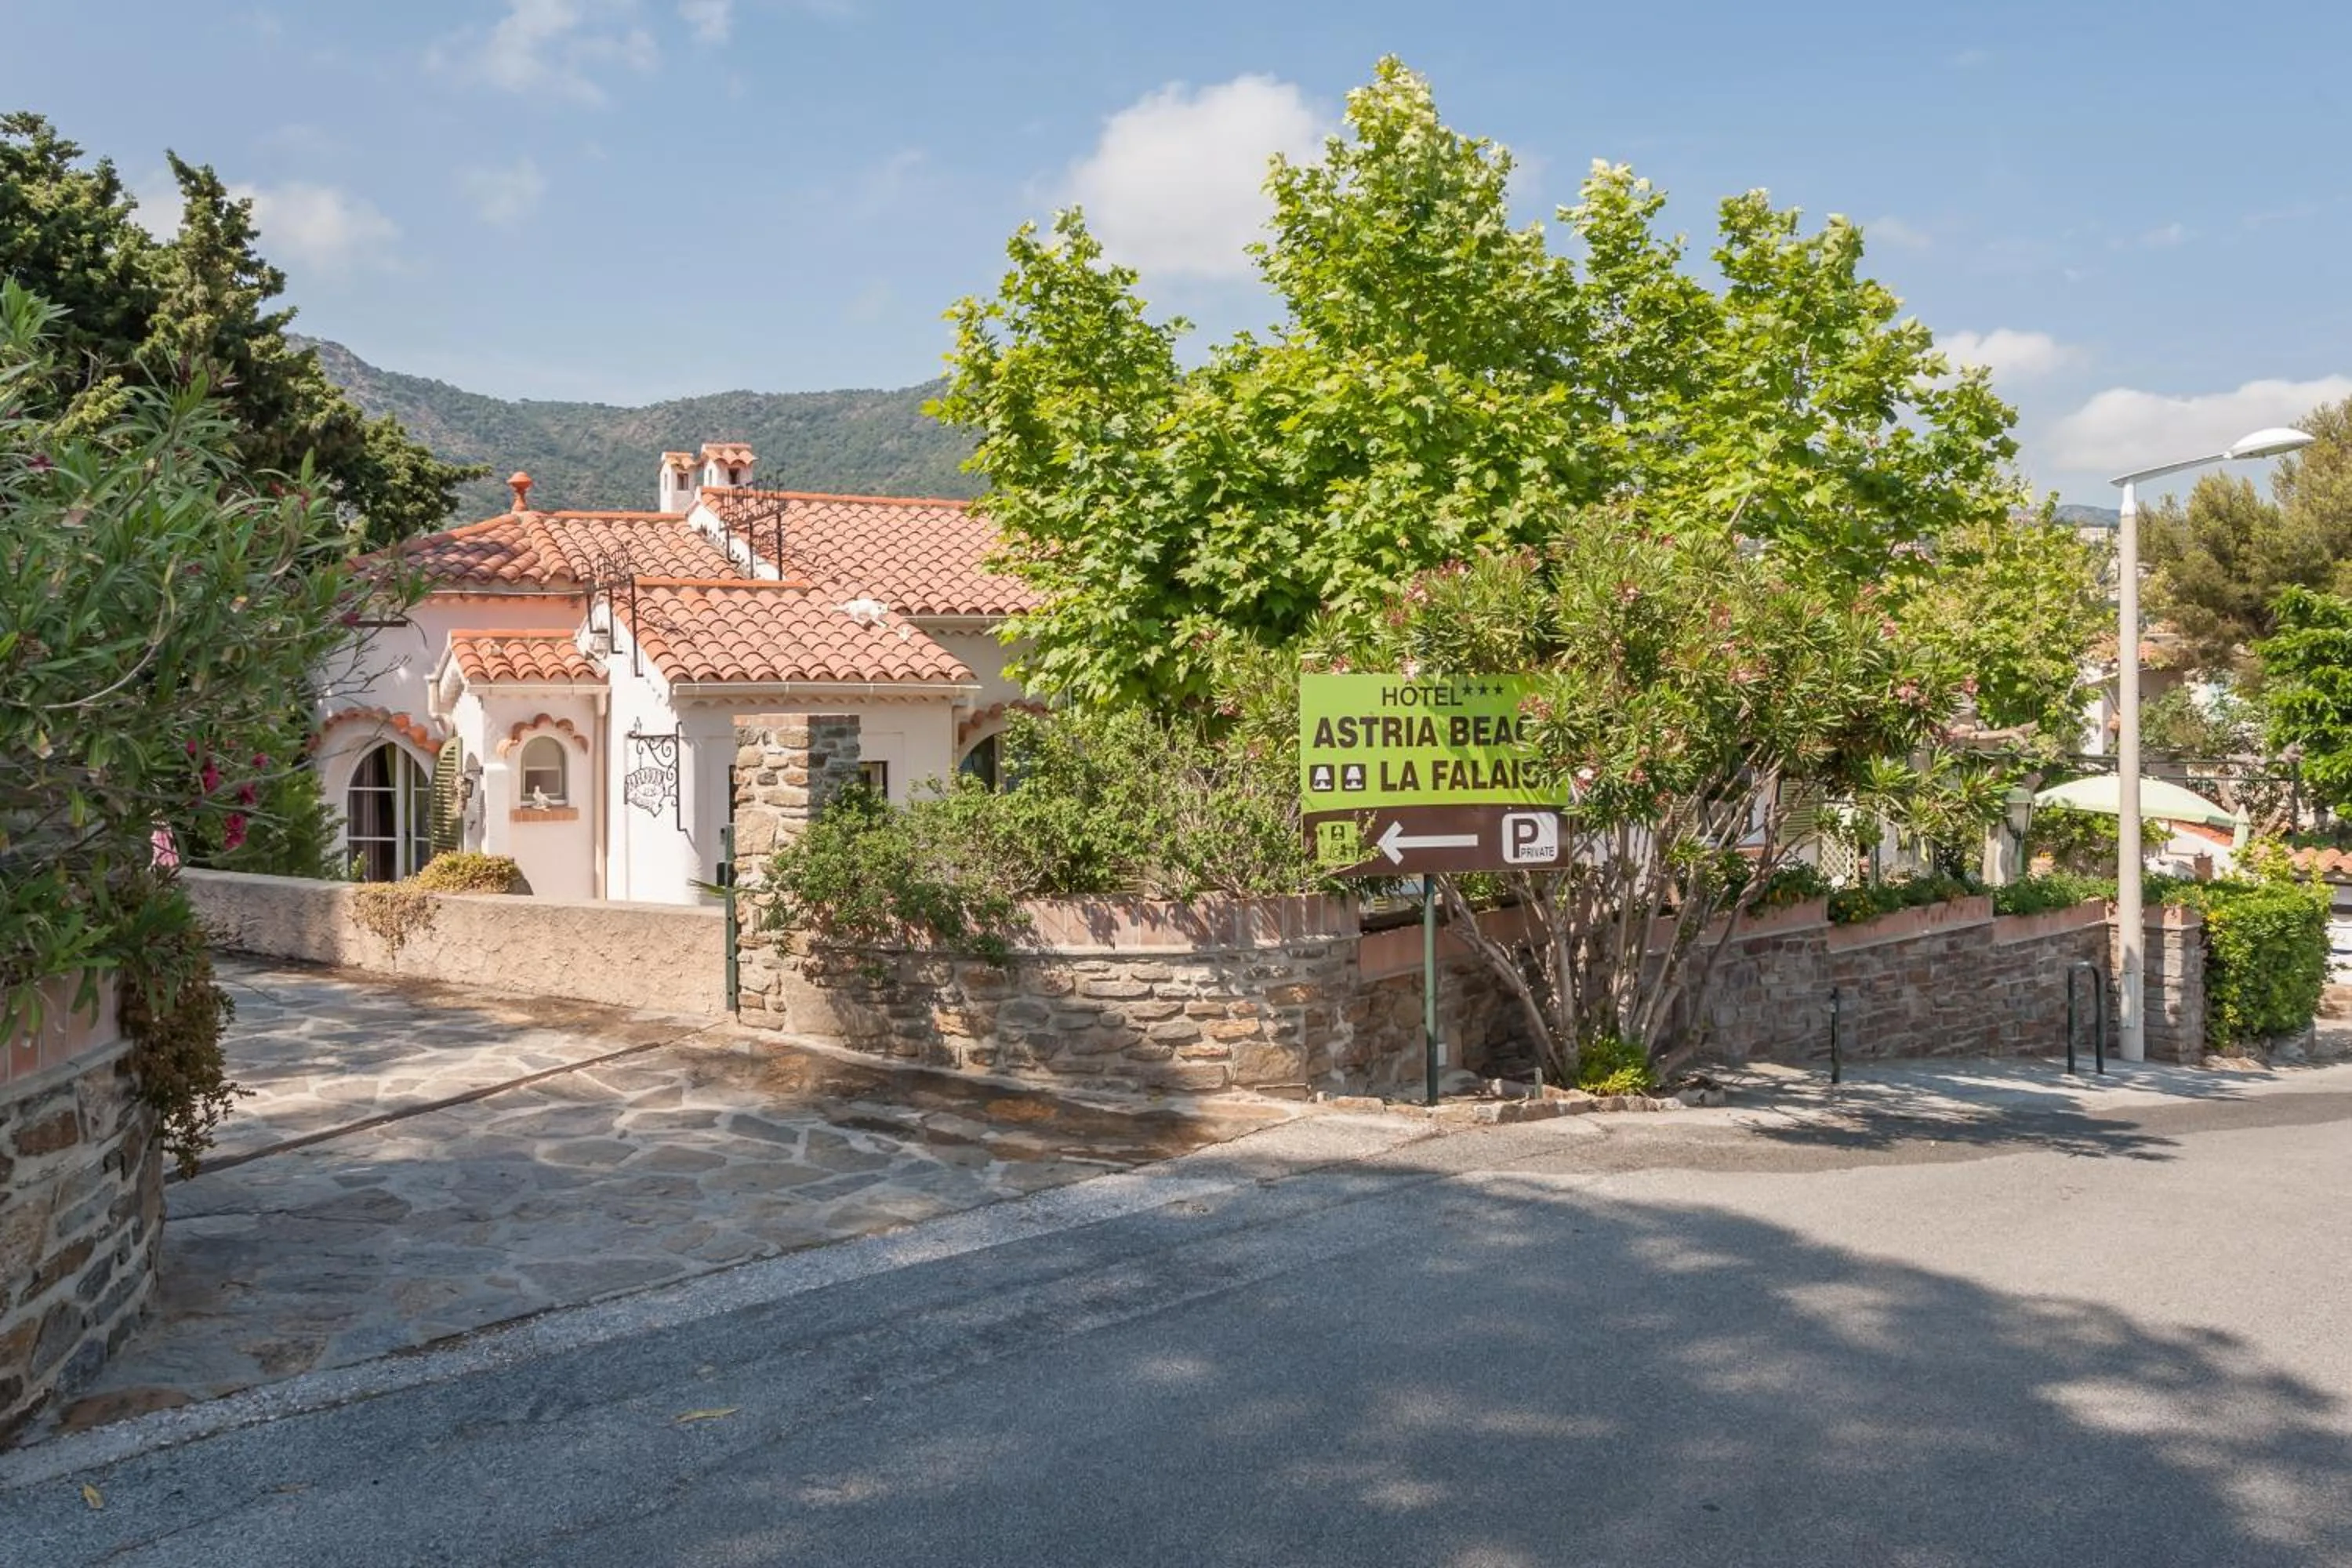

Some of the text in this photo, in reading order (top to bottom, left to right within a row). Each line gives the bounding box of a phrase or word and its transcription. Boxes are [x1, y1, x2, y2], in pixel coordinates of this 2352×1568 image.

[1313, 714, 1535, 748] ASTRIA BEAC
[1381, 758, 1543, 792] LA FALAIS
[1512, 818, 1539, 858] P
[1520, 846, 1555, 858] PRIVATE
